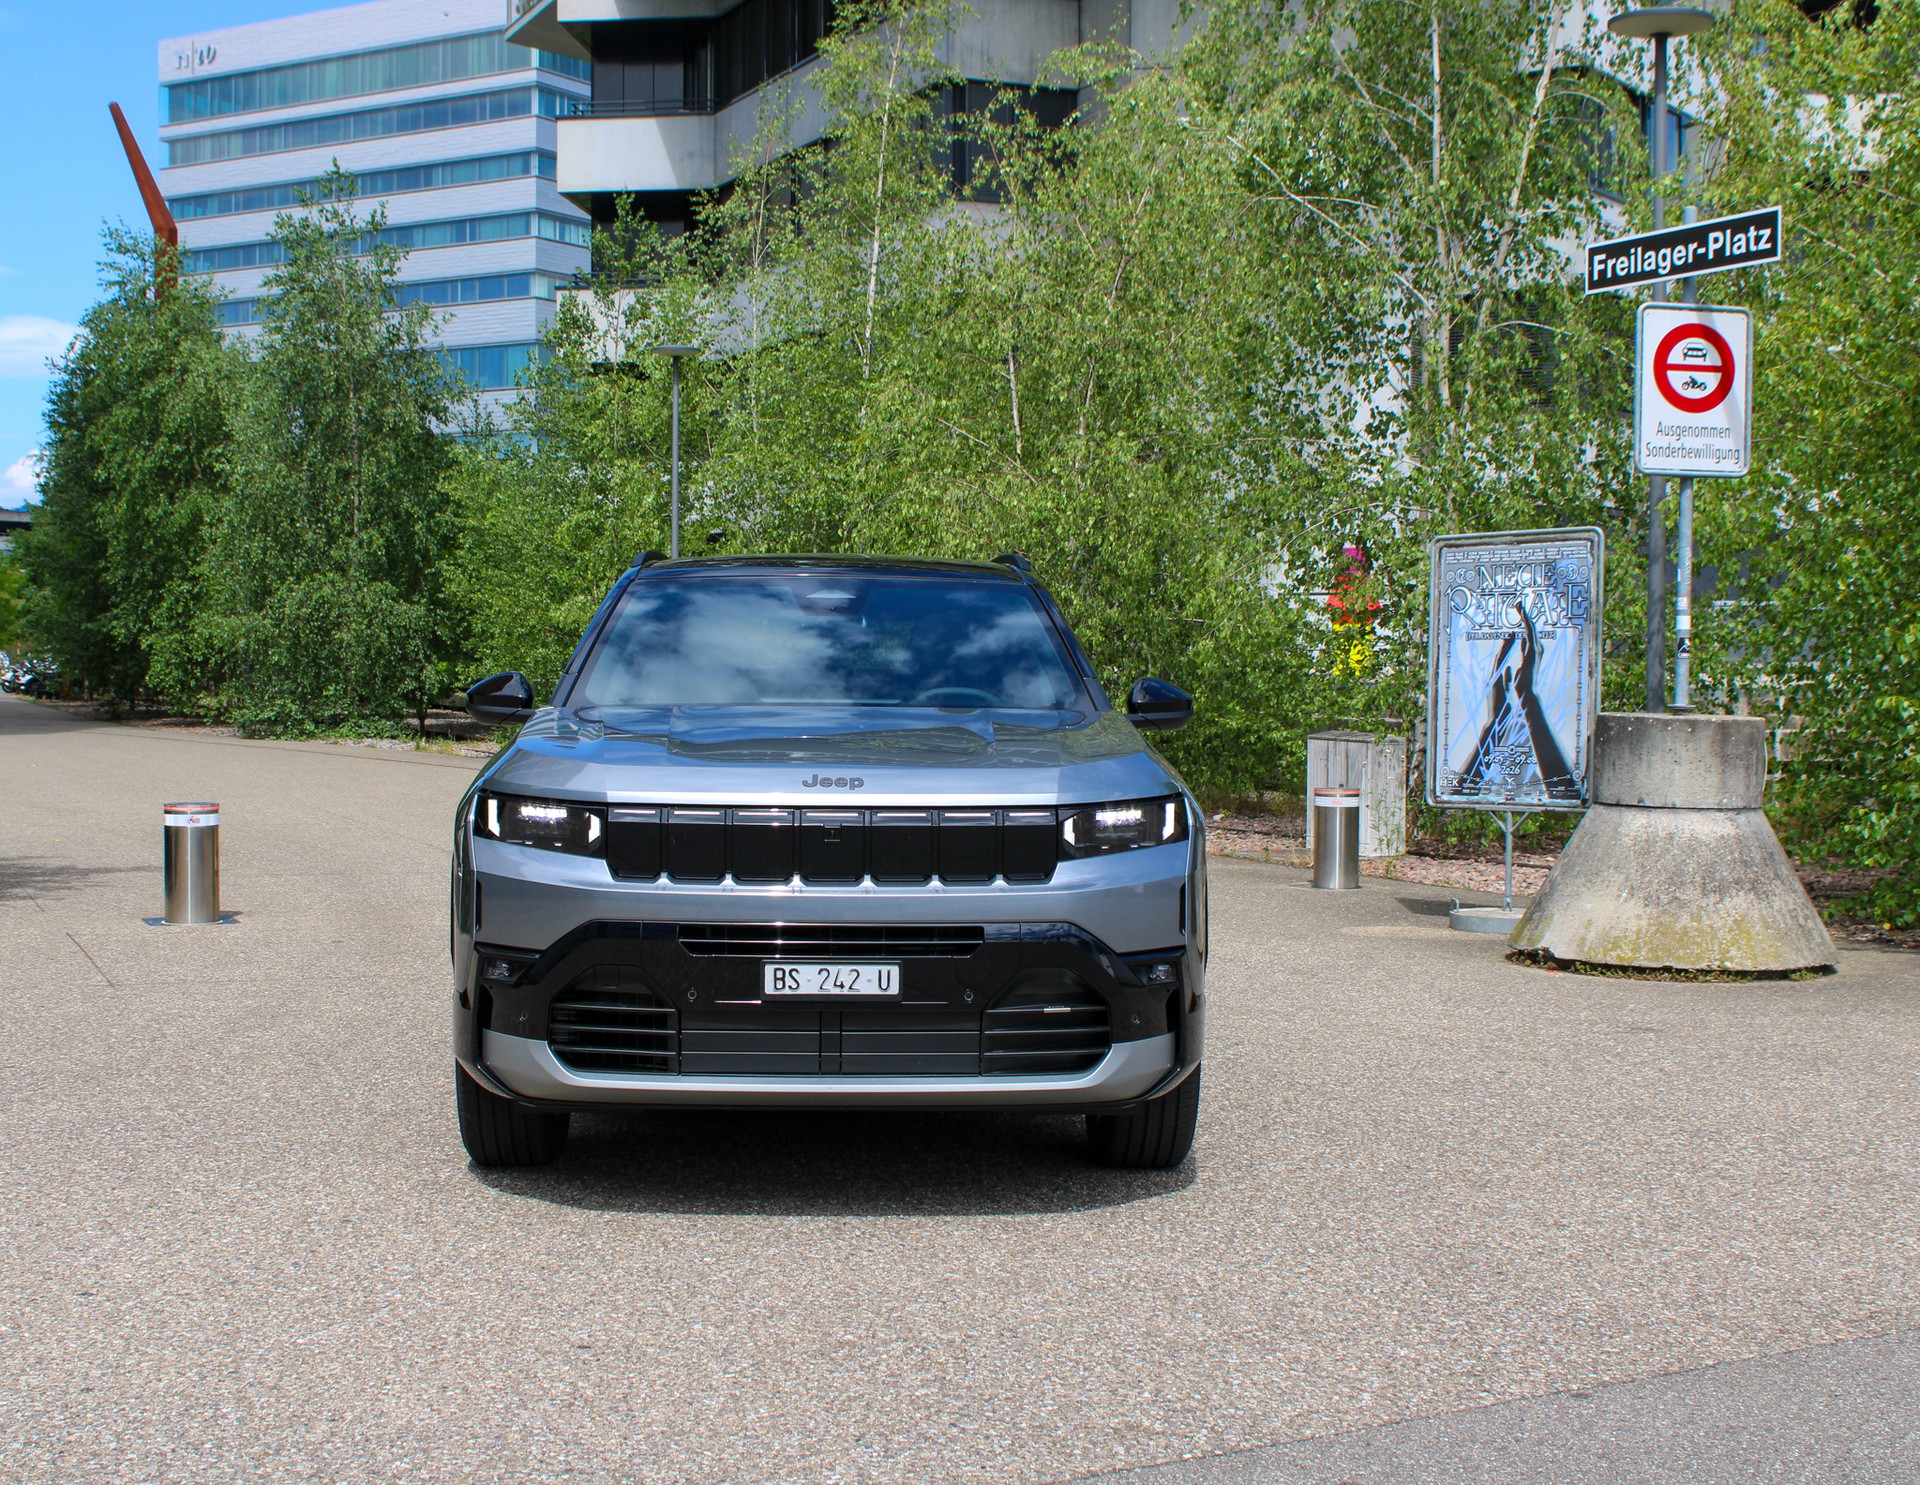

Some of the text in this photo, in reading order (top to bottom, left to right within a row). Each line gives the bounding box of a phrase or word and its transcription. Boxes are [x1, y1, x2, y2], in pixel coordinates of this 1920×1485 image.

[1592, 226, 1773, 282] Freilager-Platz
[1656, 421, 1731, 440] Ausgenommen
[1645, 442, 1740, 465] Sonderbewilligung
[1475, 562, 1556, 588] NEUE
[1500, 765, 1521, 775] 2026
[801, 774, 864, 790] Jeep
[1440, 778, 1459, 787] HEK
[773, 968, 892, 992] BS 242 U
